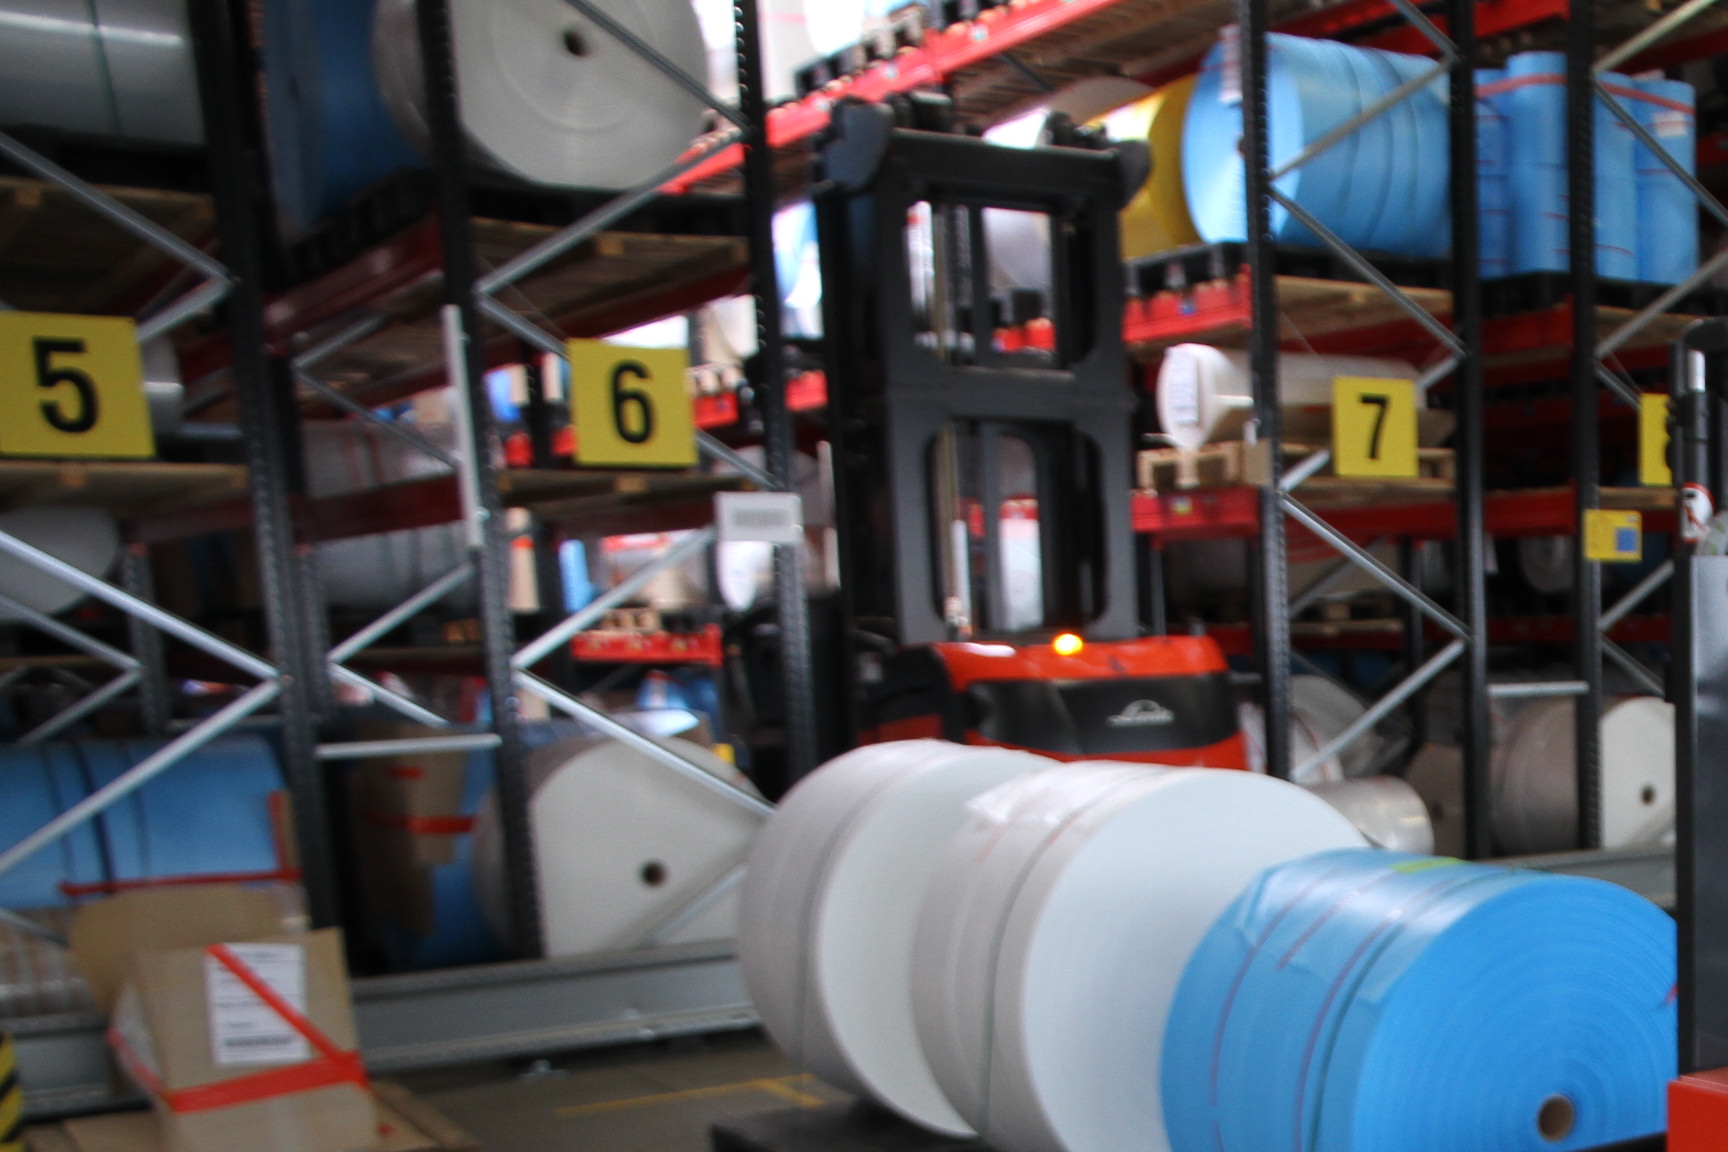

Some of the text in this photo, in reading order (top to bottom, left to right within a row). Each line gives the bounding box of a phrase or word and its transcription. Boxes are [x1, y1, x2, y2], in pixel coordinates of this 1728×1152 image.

[32, 336, 100, 433] 5
[611, 360, 656, 444] 6
[1359, 392, 1390, 460] 7
